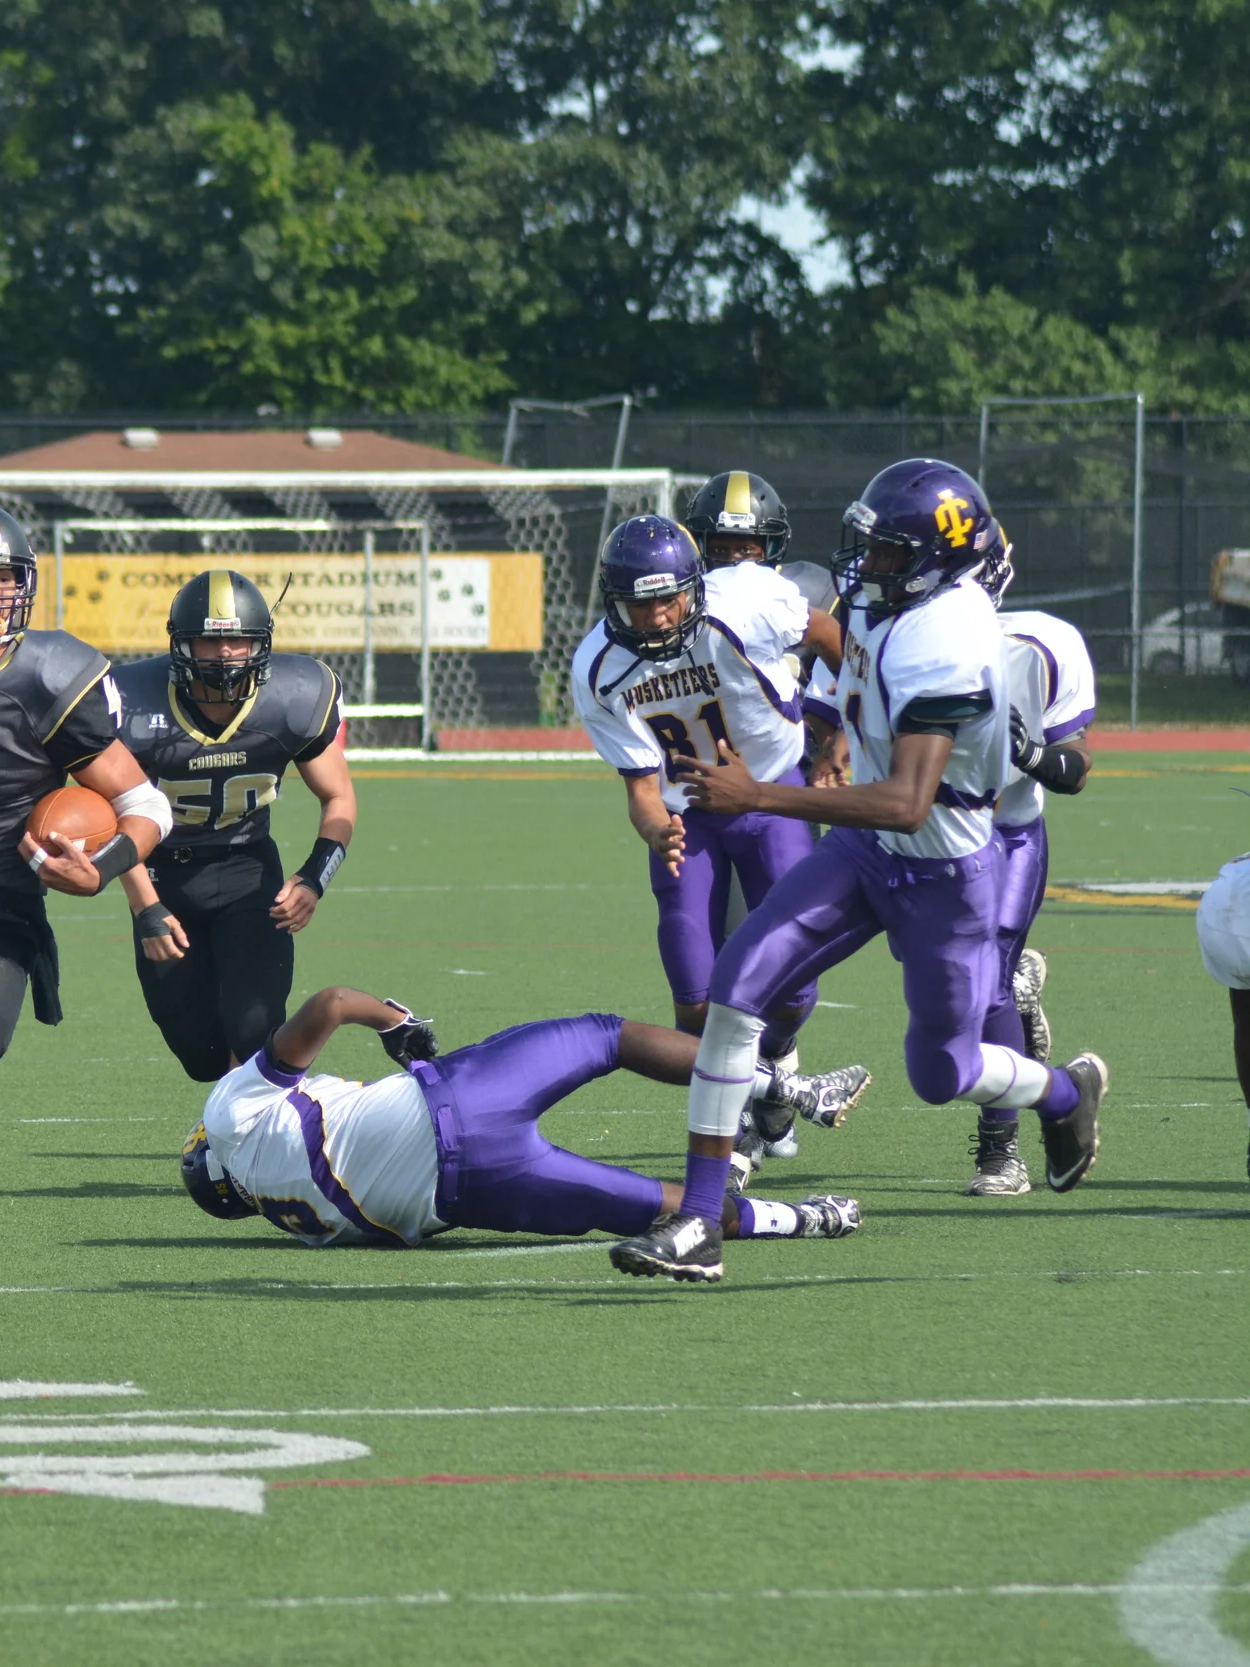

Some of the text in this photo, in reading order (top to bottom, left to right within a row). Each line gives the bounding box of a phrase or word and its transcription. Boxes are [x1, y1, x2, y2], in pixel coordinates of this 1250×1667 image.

[642, 576, 667, 586] Riddell
[273, 602, 415, 617] COUGARS
[621, 662, 720, 715] MUSKETEERS
[188, 751, 247, 771] COUGARS
[155, 773, 278, 831] 50
